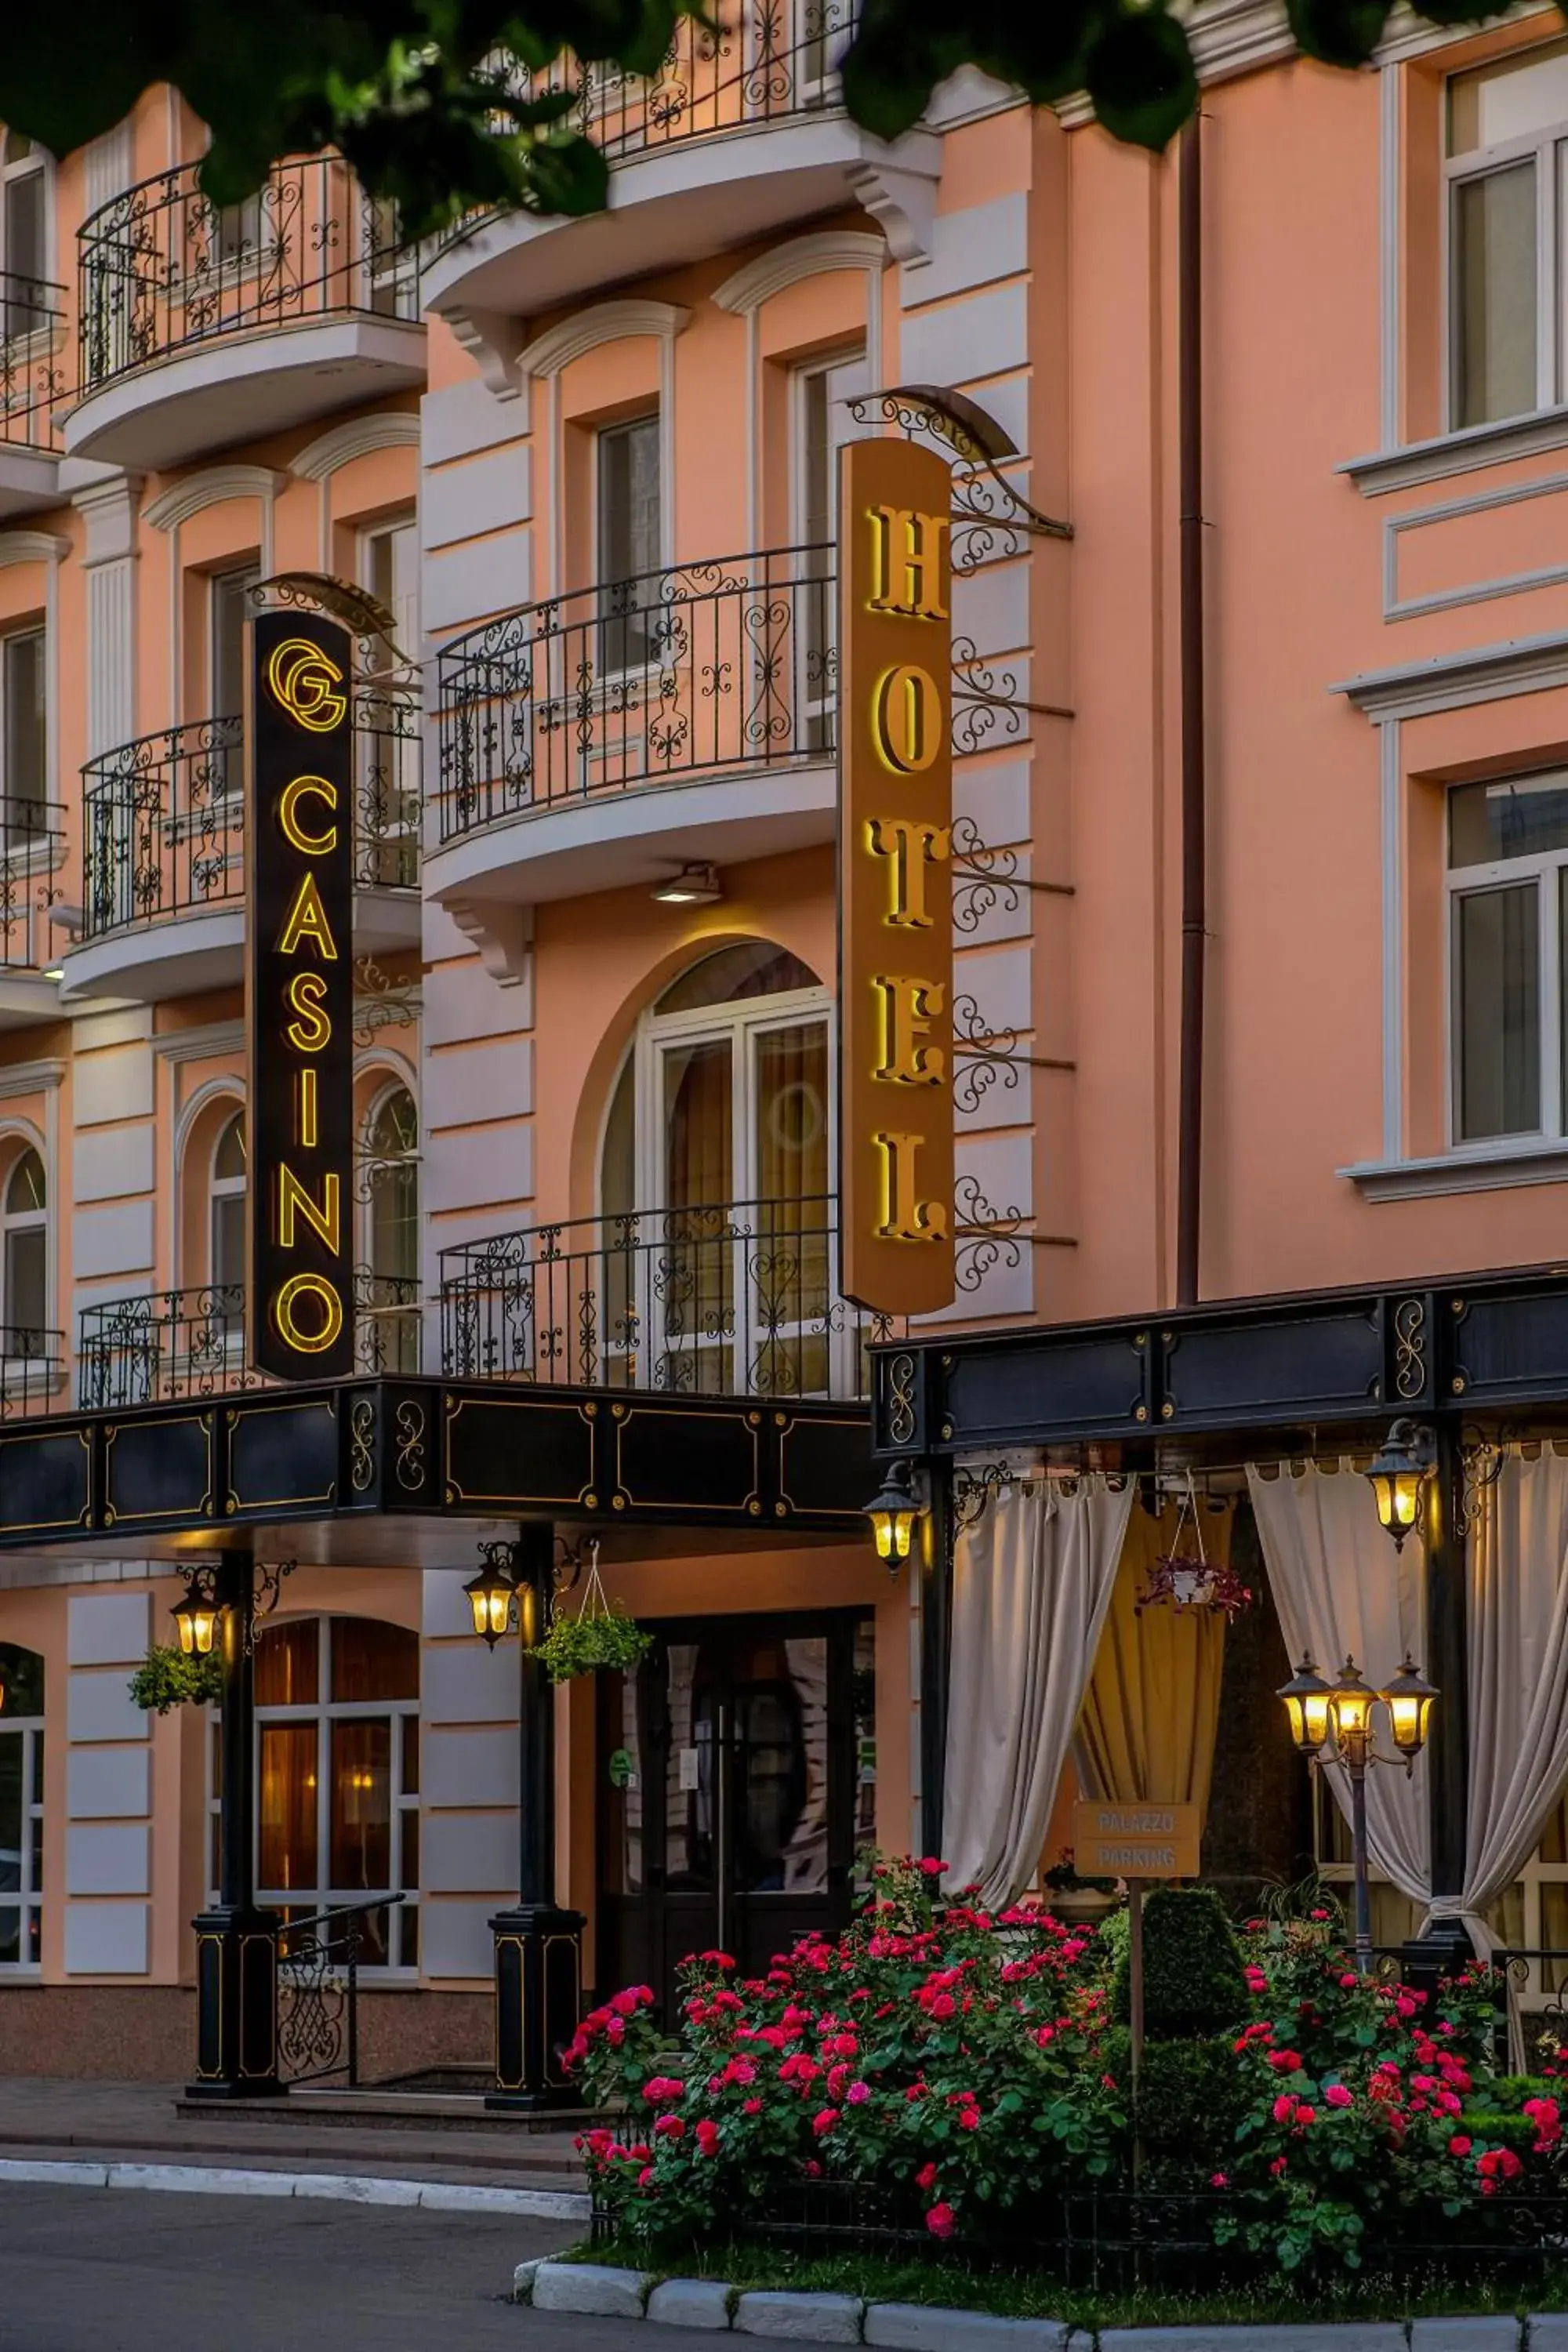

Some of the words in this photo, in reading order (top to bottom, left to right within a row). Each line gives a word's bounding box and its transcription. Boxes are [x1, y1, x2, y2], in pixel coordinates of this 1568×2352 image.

[863, 503, 952, 1243] HOTEL
[276, 773, 343, 1354] CASINO
[1099, 1811, 1174, 1832] PALAZZO
[1099, 1847, 1176, 1868] PARKING
